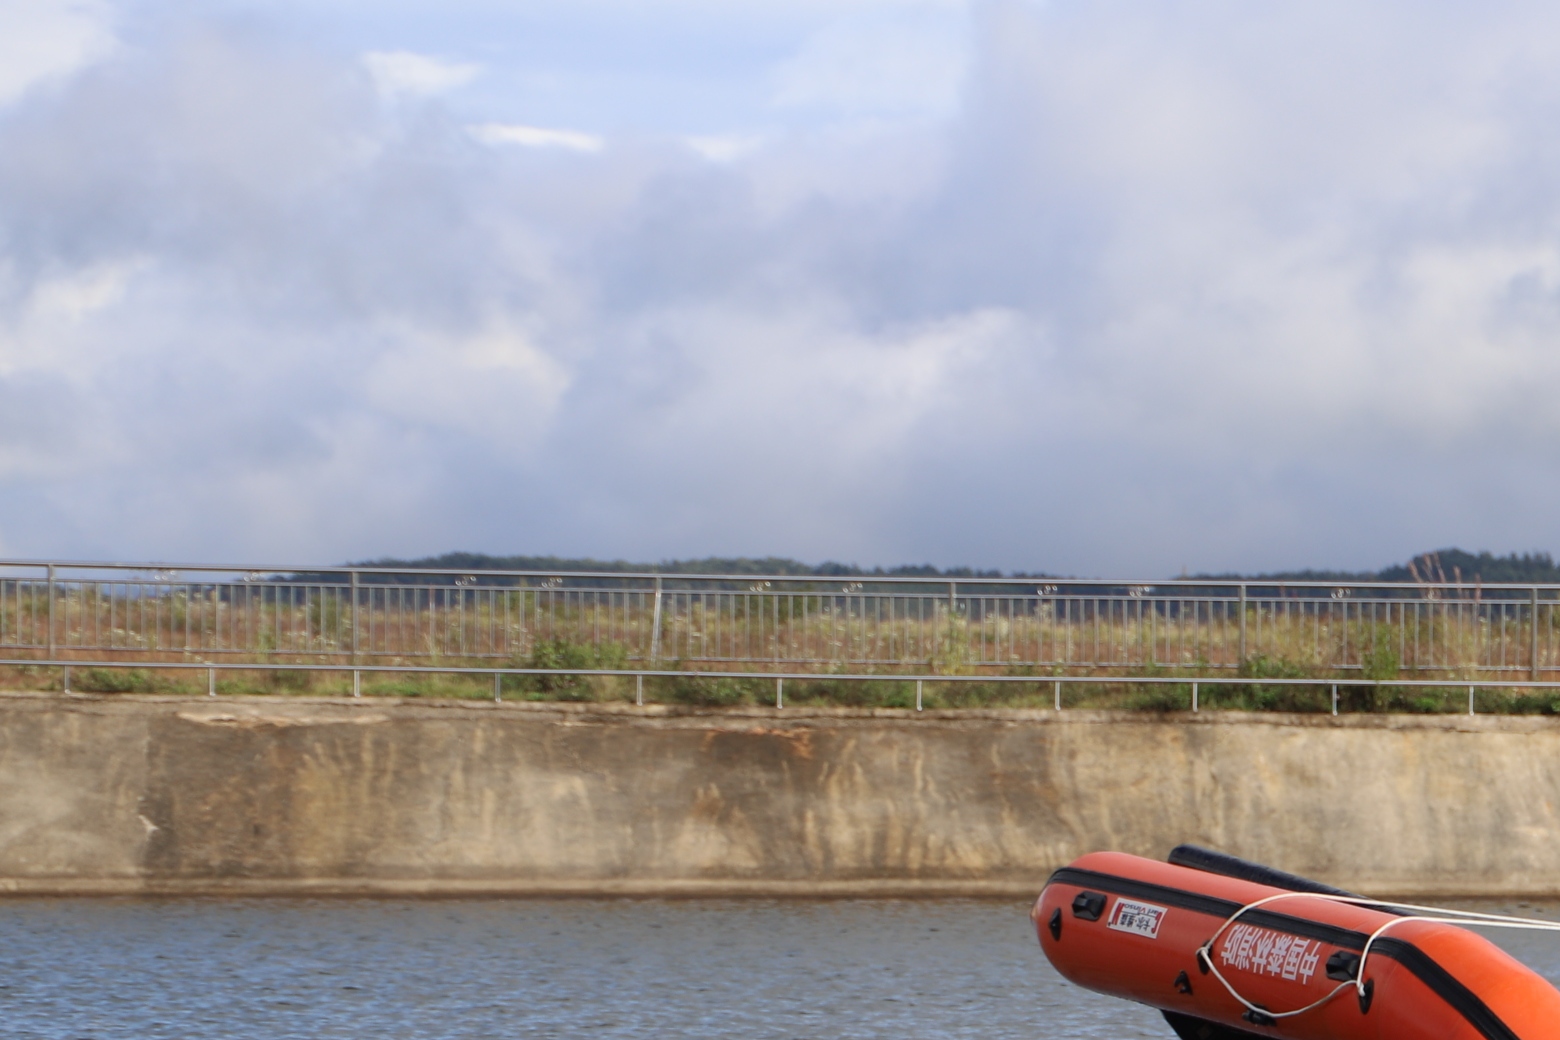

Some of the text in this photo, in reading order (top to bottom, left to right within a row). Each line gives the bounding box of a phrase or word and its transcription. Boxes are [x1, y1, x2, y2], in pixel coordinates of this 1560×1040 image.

[1221, 924, 1321, 985] 中国森林消防
